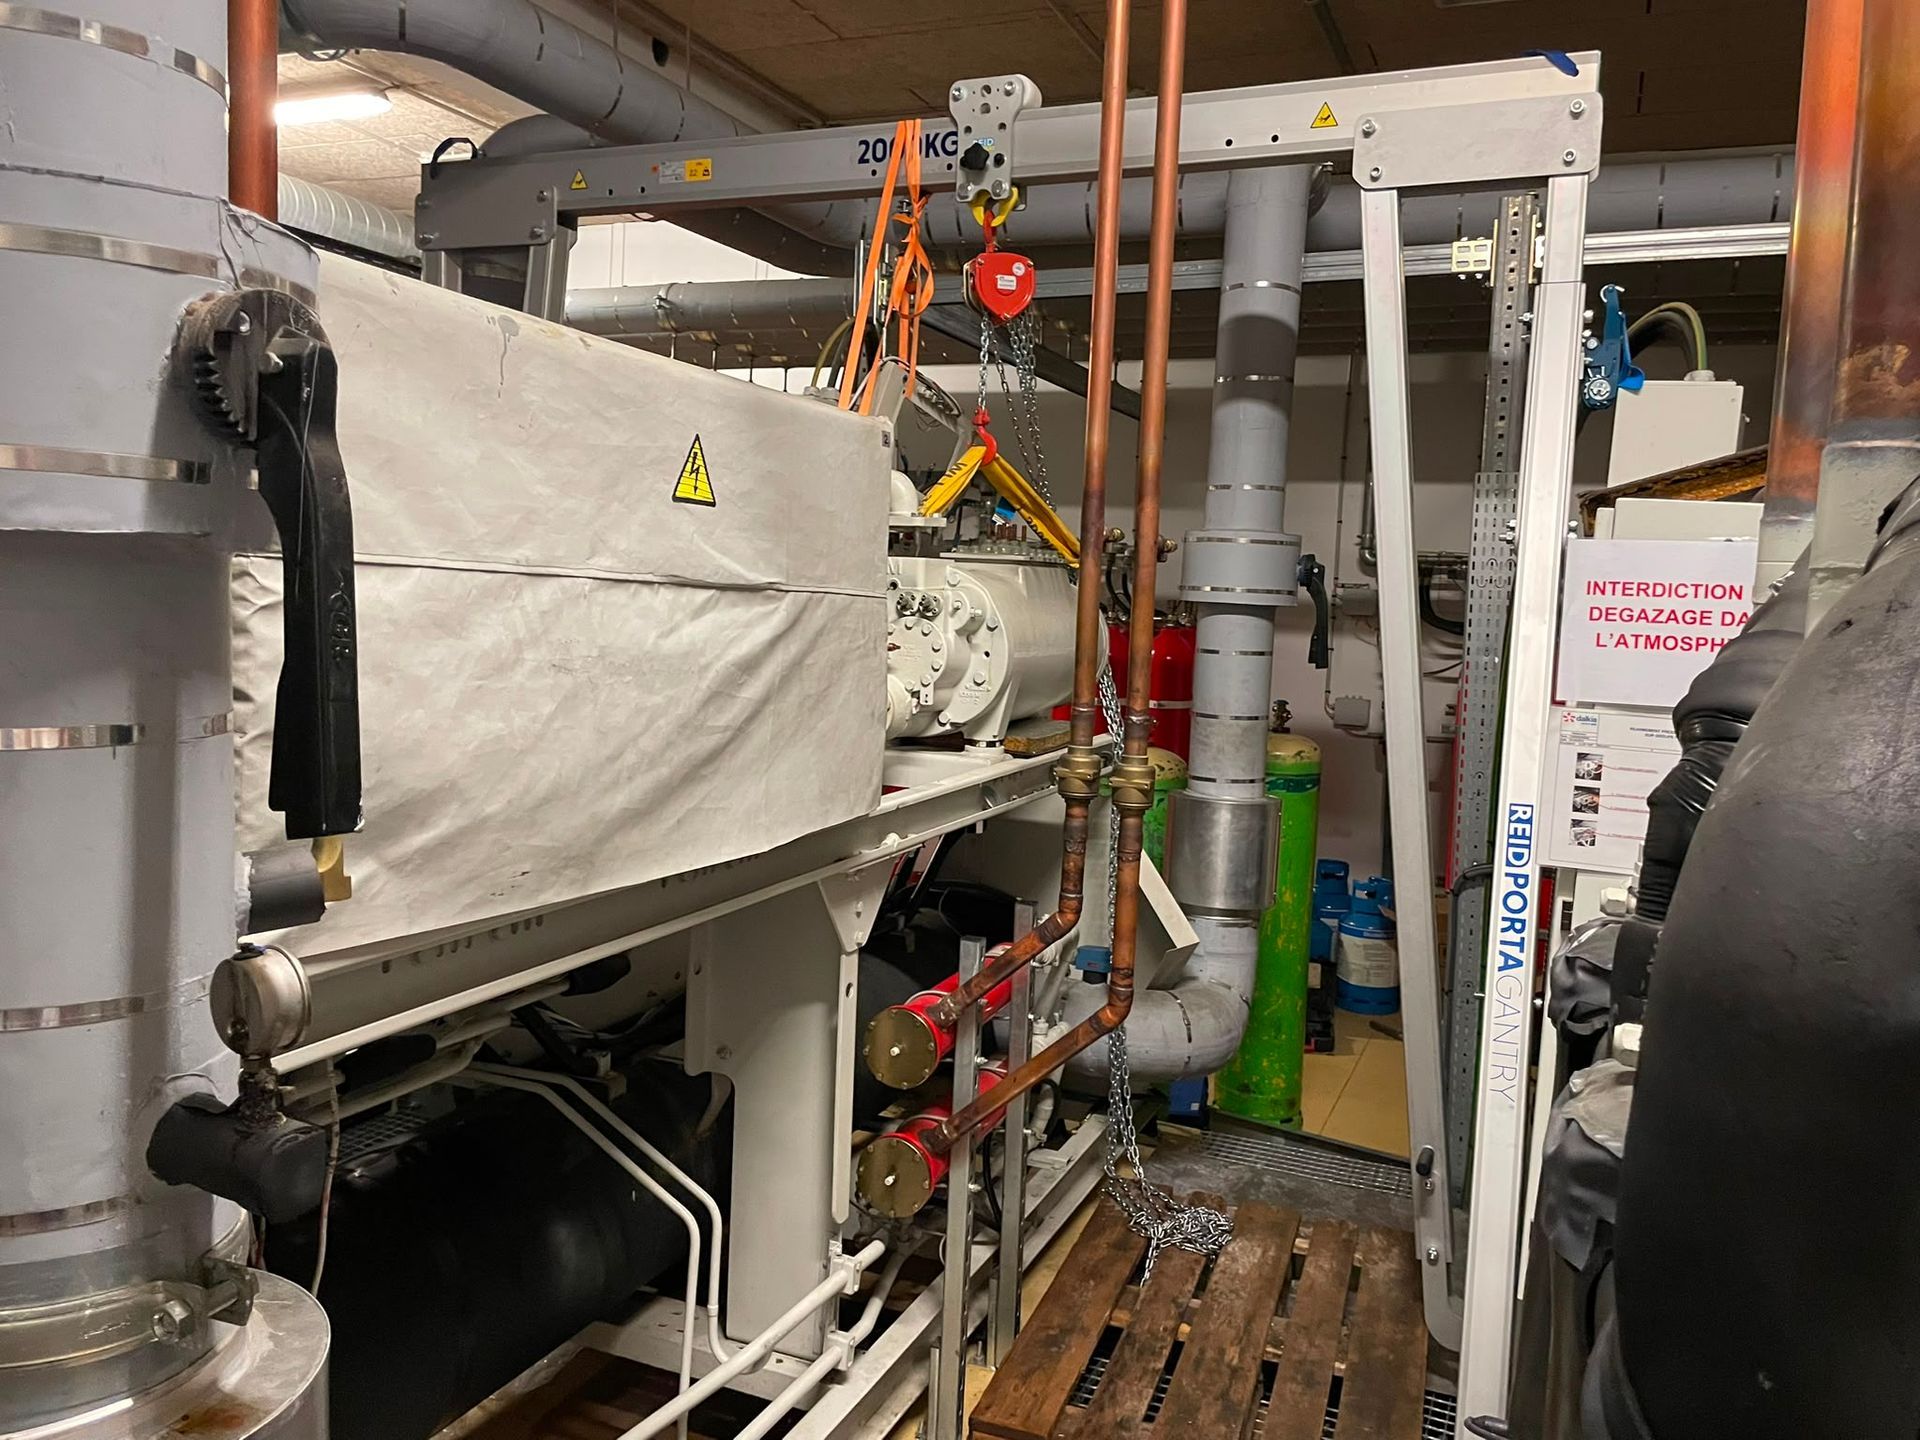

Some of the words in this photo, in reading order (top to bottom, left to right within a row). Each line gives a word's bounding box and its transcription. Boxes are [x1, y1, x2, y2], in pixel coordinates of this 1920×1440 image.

[1586, 580, 1744, 600] INTERDICTION
[1589, 606, 1713, 626] DEGAZAGE
[1596, 632, 1730, 653] L'ATMOSPH
[1505, 803, 1534, 867] REID
